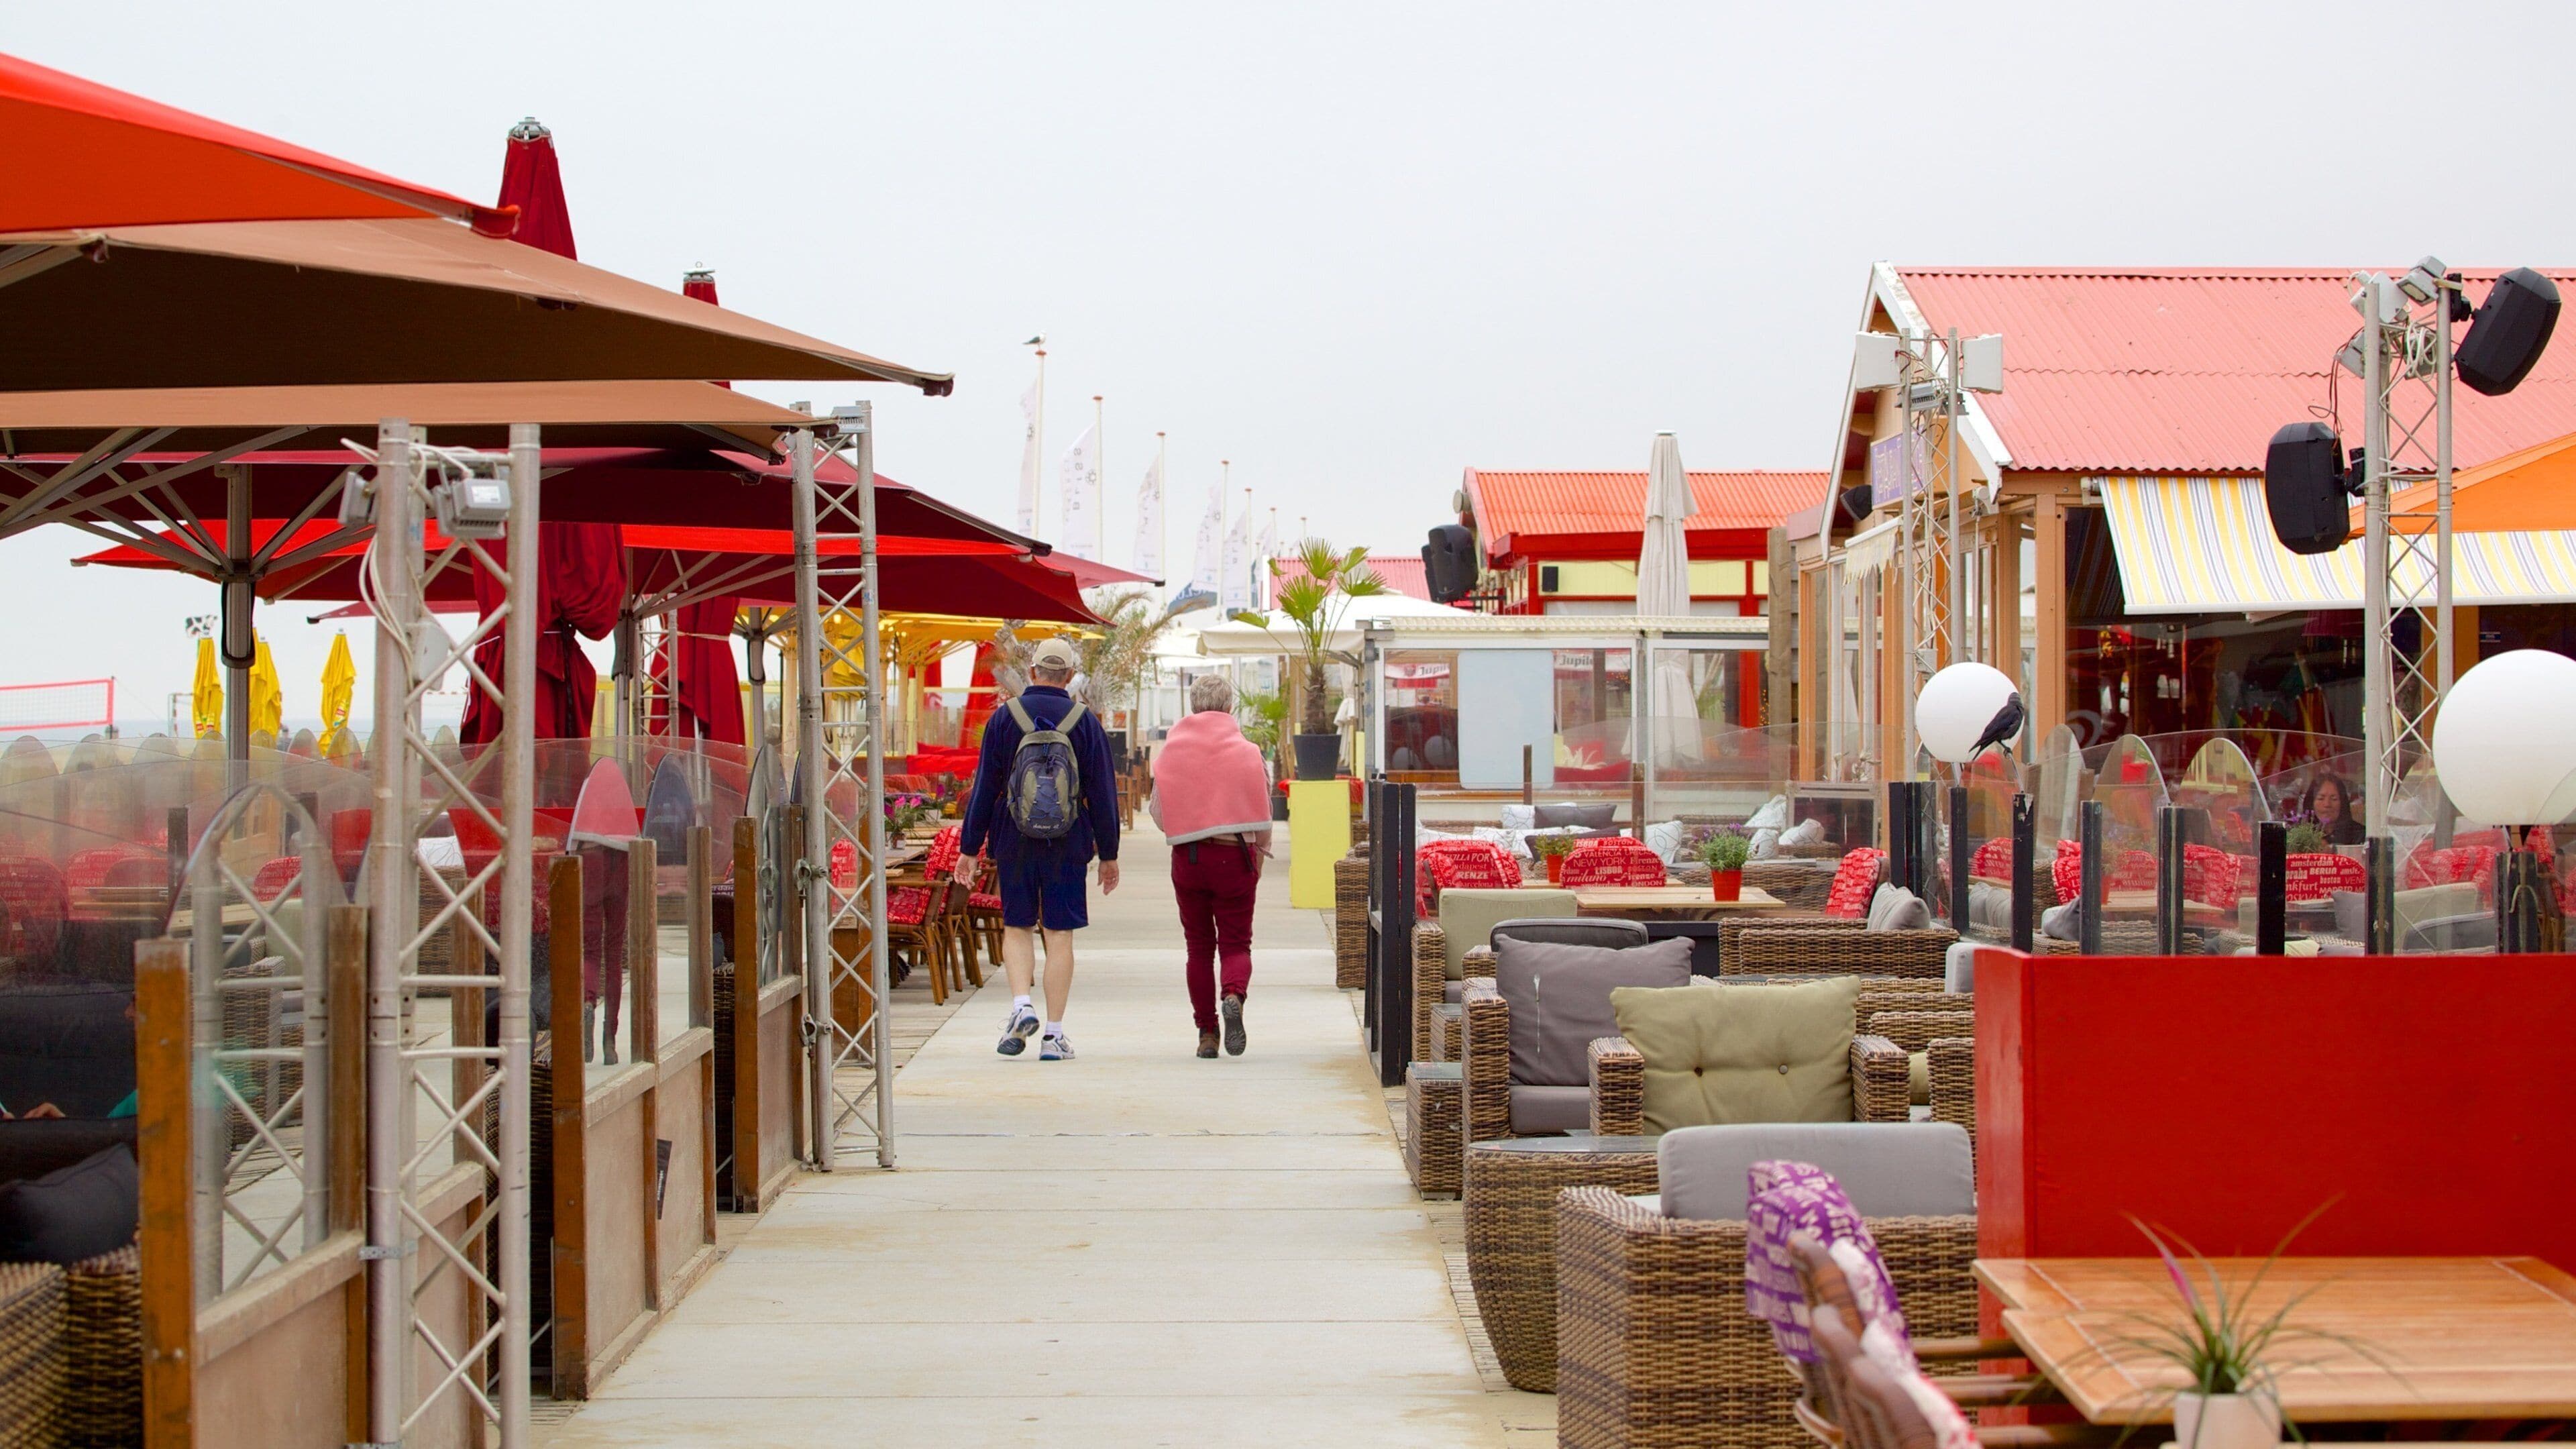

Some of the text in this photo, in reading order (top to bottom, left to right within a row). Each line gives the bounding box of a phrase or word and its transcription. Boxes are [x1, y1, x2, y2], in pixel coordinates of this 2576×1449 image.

[1573, 858, 1597, 867] NEW
[1601, 856, 1626, 866] YORK
[2290, 859, 2334, 867] amsterdam
[1595, 865, 1623, 875] LISBOA
[2309, 867, 2337, 875] BERLIN
[1566, 869, 1607, 883] milano
[2320, 876, 2341, 884] boston
